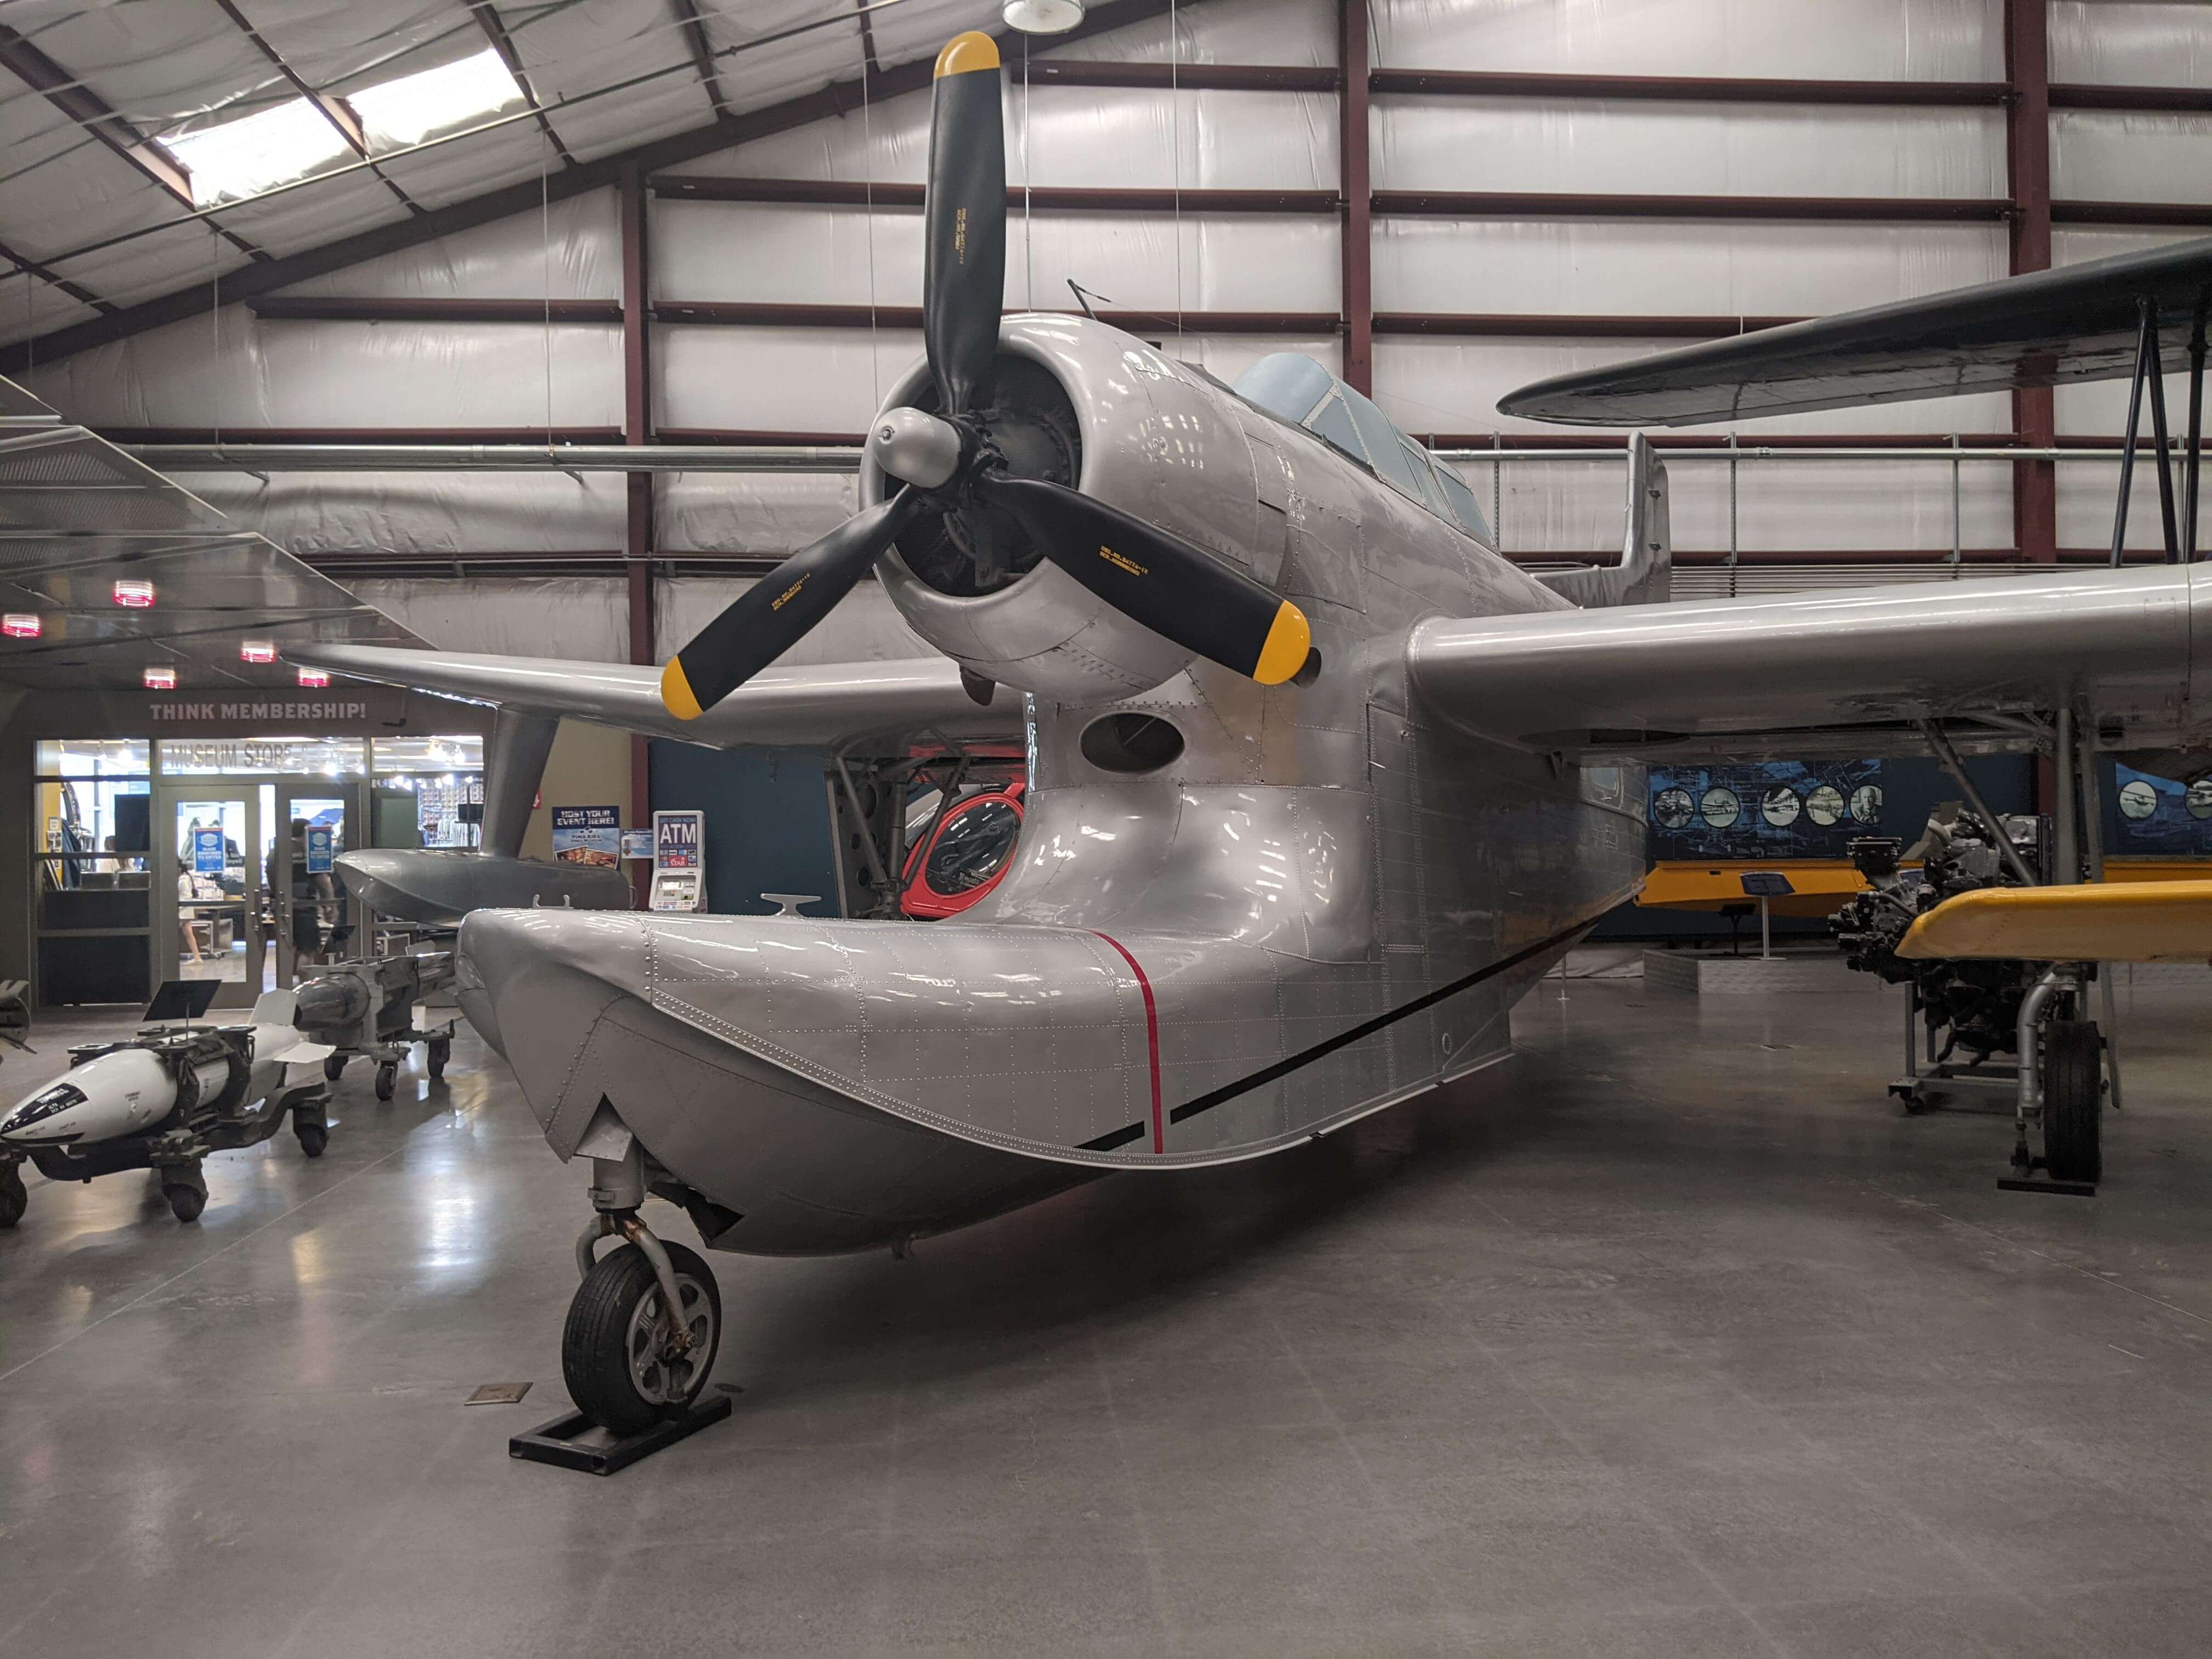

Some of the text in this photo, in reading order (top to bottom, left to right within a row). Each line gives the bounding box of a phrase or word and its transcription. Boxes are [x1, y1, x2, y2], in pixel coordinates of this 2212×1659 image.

[150, 703, 366, 720] THINK MEMBERSHIP!
[171, 744, 237, 768] MUSEUM
[659, 823, 696, 844] ATM
